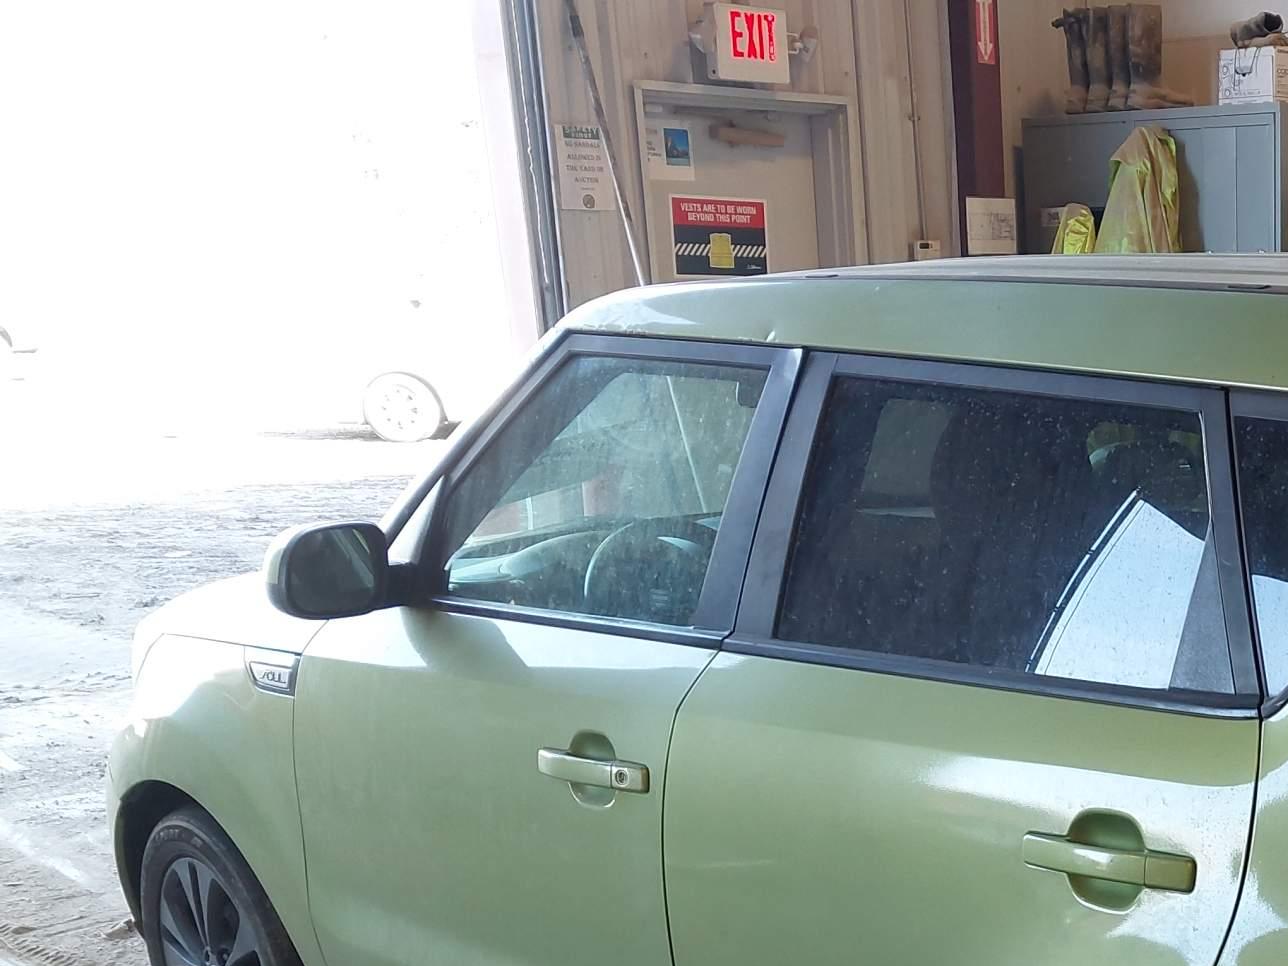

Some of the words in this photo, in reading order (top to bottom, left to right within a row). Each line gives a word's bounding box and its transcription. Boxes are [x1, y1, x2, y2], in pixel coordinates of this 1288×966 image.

[729, 10, 775, 61] EXIT
[680, 202, 702, 212] VESTS
[702, 203, 717, 212] ARE
[717, 204, 726, 213] TO
[726, 204, 737, 214] BE
[736, 205, 757, 215] WORN
[687, 212, 715, 222] BEYOND
[715, 213, 731, 222] THIS
[731, 214, 752, 224] POINT
